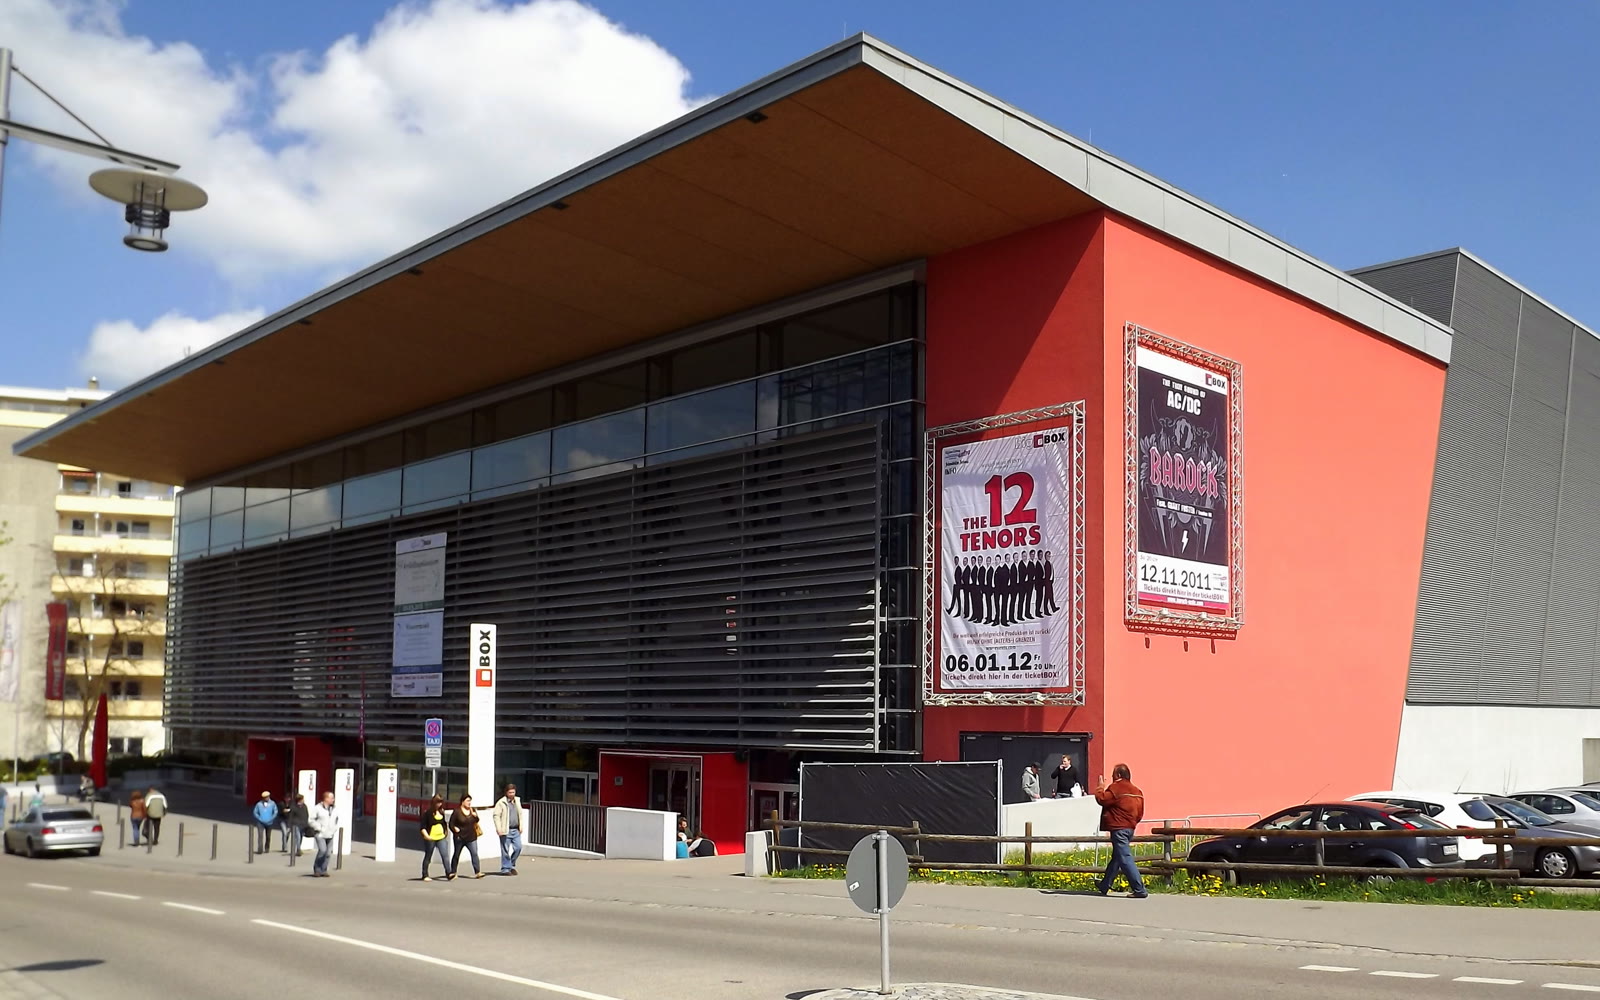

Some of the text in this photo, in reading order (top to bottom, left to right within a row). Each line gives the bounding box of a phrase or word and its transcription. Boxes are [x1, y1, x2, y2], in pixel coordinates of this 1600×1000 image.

[1211, 377, 1226, 390] BOX
[1167, 390, 1201, 416] AC/DC
[1044, 432, 1065, 444] BOX
[1149, 446, 1219, 500] BAROCK
[962, 471, 1037, 530] THE 12
[960, 525, 1041, 552] TENORS
[1141, 563, 1211, 591] 12.11.2011
[479, 630, 491, 666] BOX
[945, 652, 1032, 672] 06.01.12
[945, 672, 966, 681] Tickets
[968, 672, 986, 680] direkt
